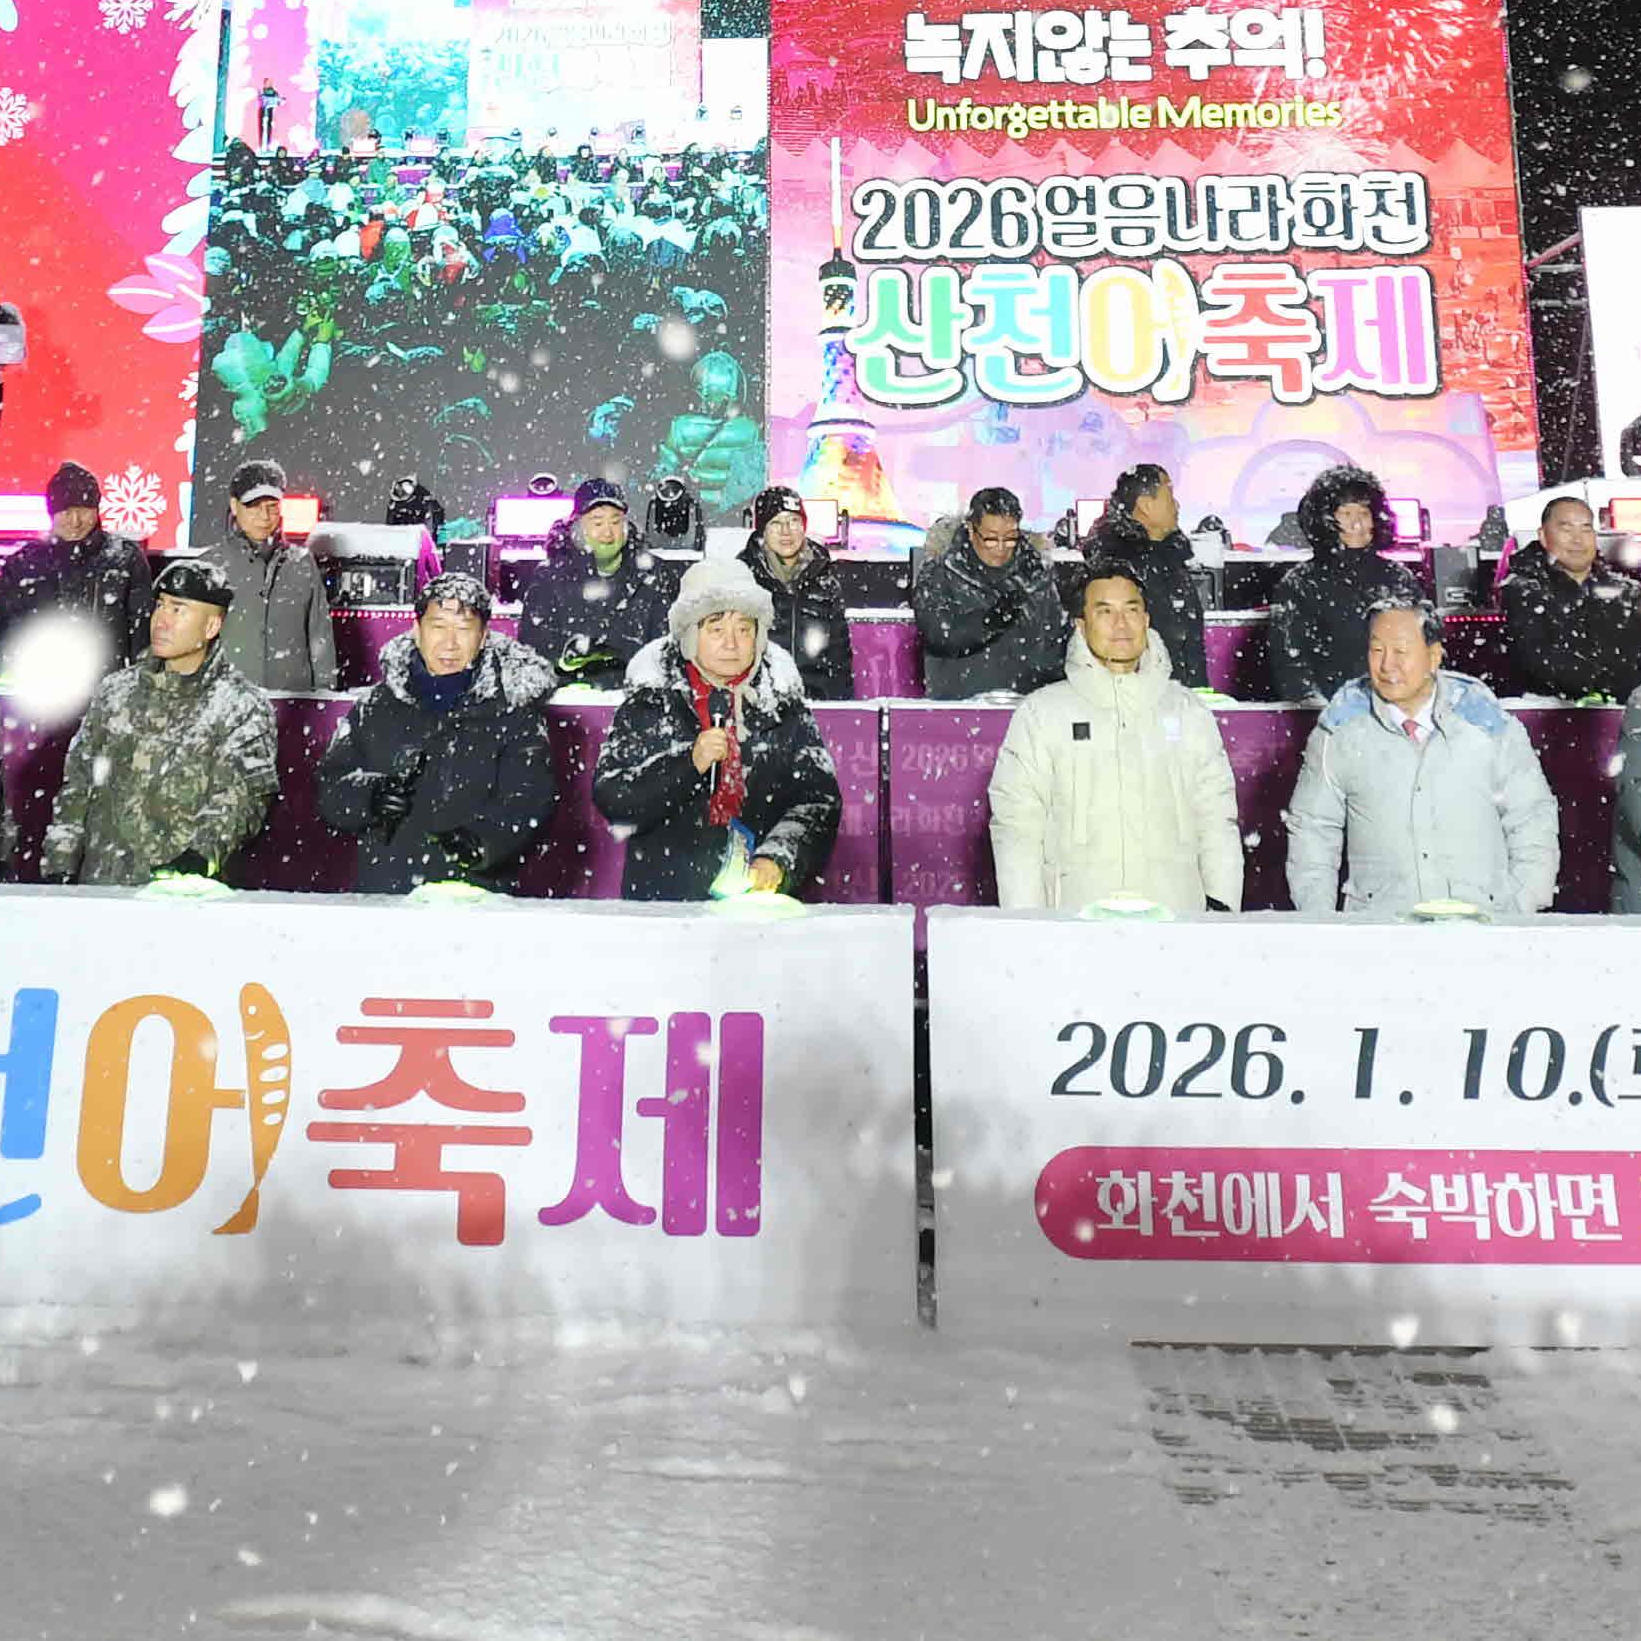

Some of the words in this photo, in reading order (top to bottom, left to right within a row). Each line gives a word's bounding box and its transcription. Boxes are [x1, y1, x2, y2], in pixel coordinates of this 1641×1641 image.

[903, 10, 1152, 84] 녹지않는
[1164, 8, 1326, 83] 추억!
[907, 97, 1151, 138] Unforgettable
[1155, 96, 1342, 131] Memories
[1050, 1020, 1307, 1103] 2026.
[1094, 1170, 1344, 1240] 화천에서
[1367, 1172, 1622, 1243] 숙박하면
